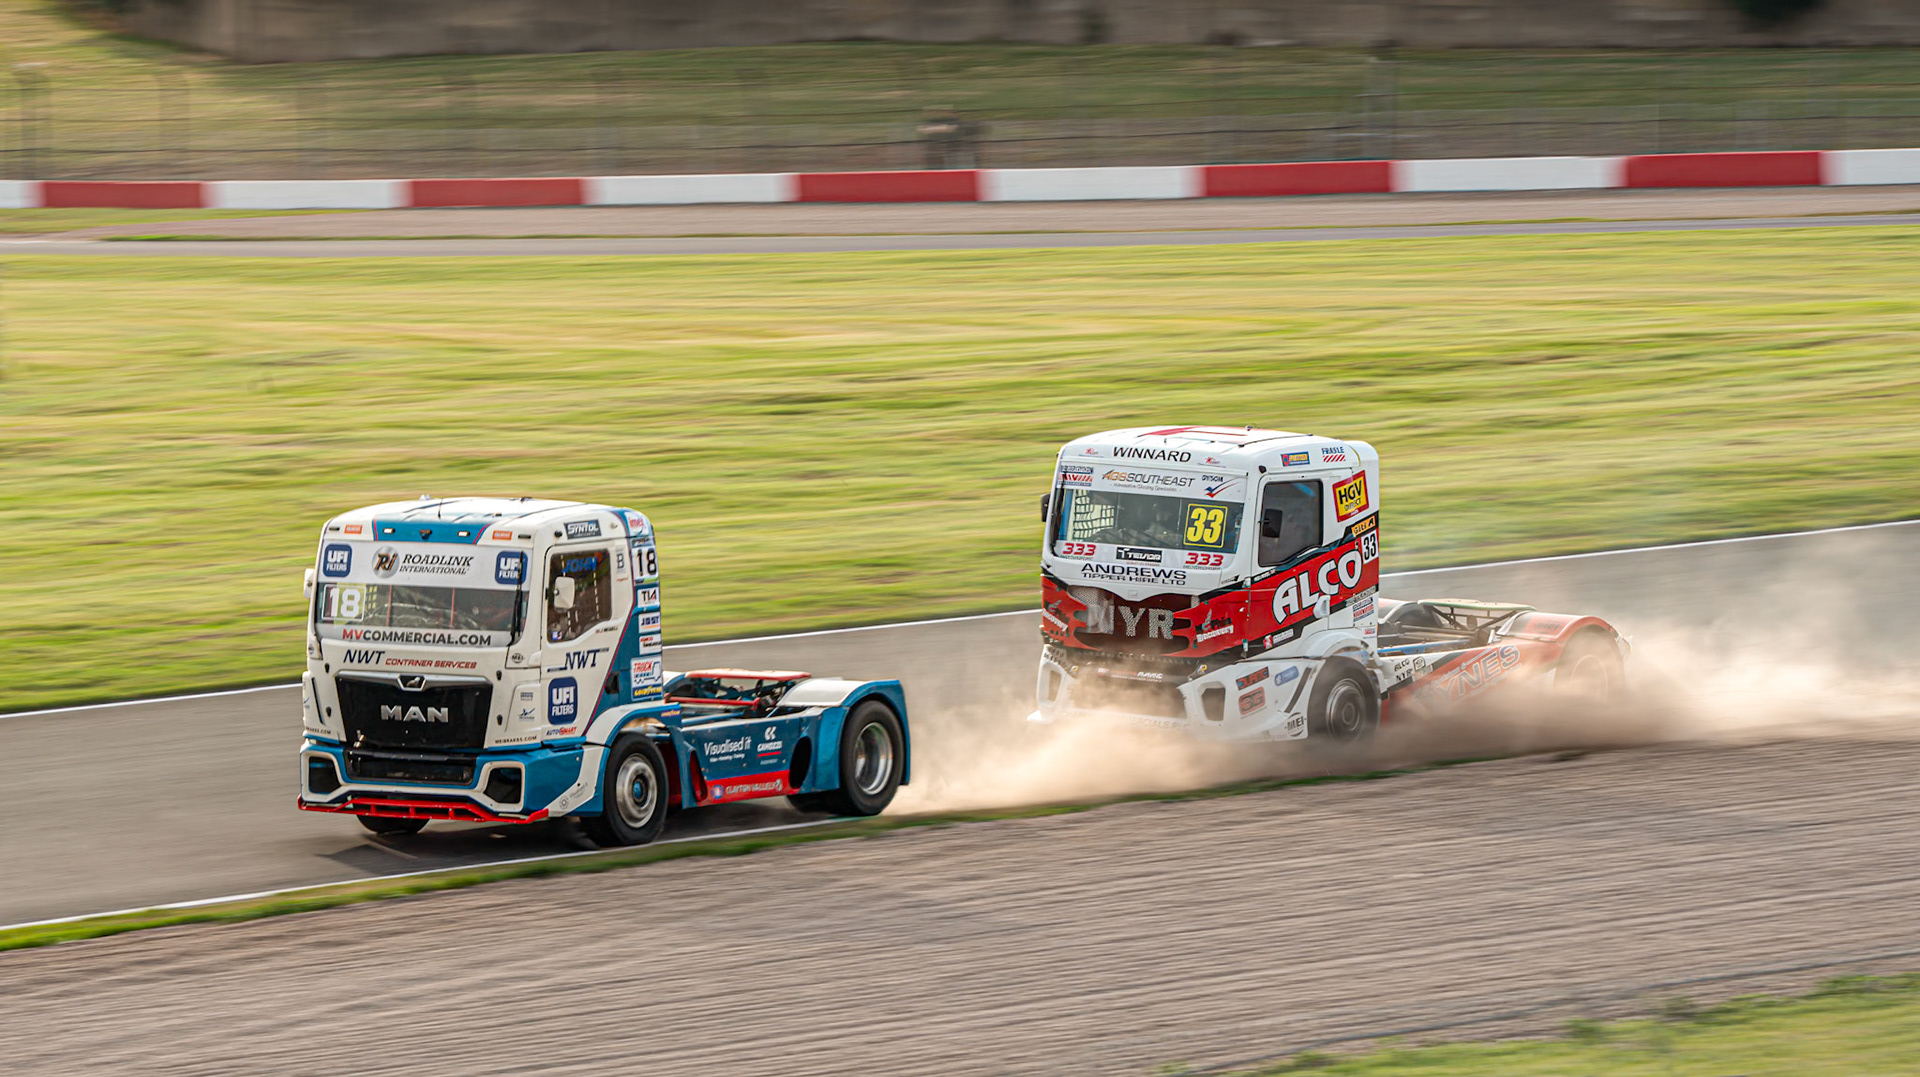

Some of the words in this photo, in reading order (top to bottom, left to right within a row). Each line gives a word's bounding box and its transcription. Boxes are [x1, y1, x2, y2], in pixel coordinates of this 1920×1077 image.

[1113, 446, 1191, 463] WINNARD
[1338, 480, 1362, 505] HGV
[567, 522, 600, 535] SYNTOL
[1186, 507, 1224, 544] 33
[1062, 542, 1097, 556] 333
[1363, 533, 1377, 561] 33
[327, 550, 349, 563] UFI
[402, 554, 475, 566] ROADLINK
[500, 557, 522, 571] UF
[562, 557, 598, 573] JOHN
[636, 548, 657, 577] 18
[1185, 552, 1224, 566] 333
[399, 565, 468, 575] INTERNATIONAL
[1081, 563, 1187, 580] ANDREWS
[1081, 572, 1126, 581] TIPPER
[1129, 576, 1159, 584] HIRE
[1162, 578, 1186, 586] LTD
[1272, 549, 1362, 625] ALCO
[329, 587, 361, 617] 18
[342, 628, 492, 646] MVCOMMERCIAL.COM
[343, 649, 386, 665] NWT
[385, 658, 433, 667] CONTAINER
[434, 660, 477, 669] SERVICES
[565, 649, 601, 670] NWT
[552, 686, 576, 705] UFI
[380, 704, 449, 723] MAN
[551, 704, 574, 717] FILTERS
[1287, 716, 1304, 731] MEI
[704, 736, 745, 756] Visualised
